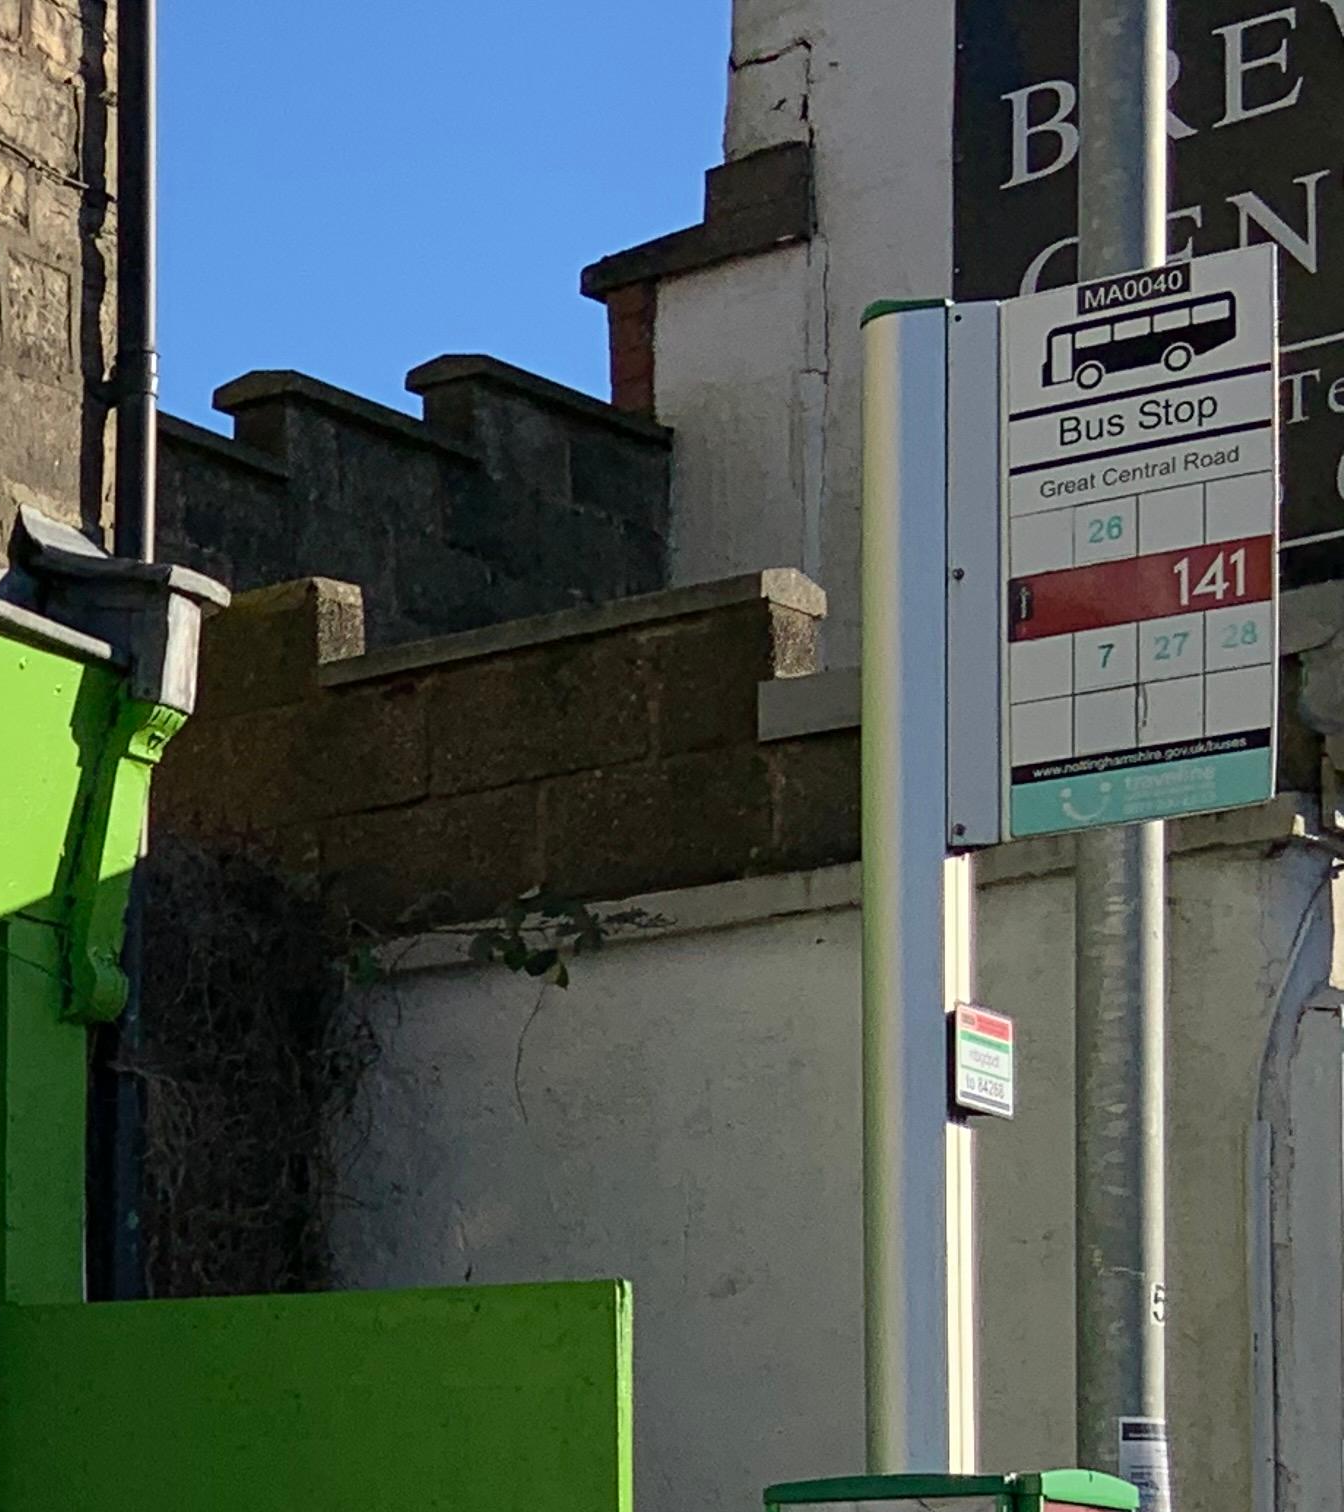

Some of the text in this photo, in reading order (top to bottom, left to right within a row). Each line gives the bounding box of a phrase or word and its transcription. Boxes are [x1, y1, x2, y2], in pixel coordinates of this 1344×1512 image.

[1085, 269, 1183, 309] MA0040
[1060, 395, 1218, 447] Bus Stop
[1040, 445, 1241, 499] Great Central Road
[1089, 515, 1123, 544] 26
[1173, 548, 1248, 607] 141
[1154, 632, 1191, 660] 27
[1222, 620, 1259, 649] 28
[1098, 643, 1116, 669] 7
